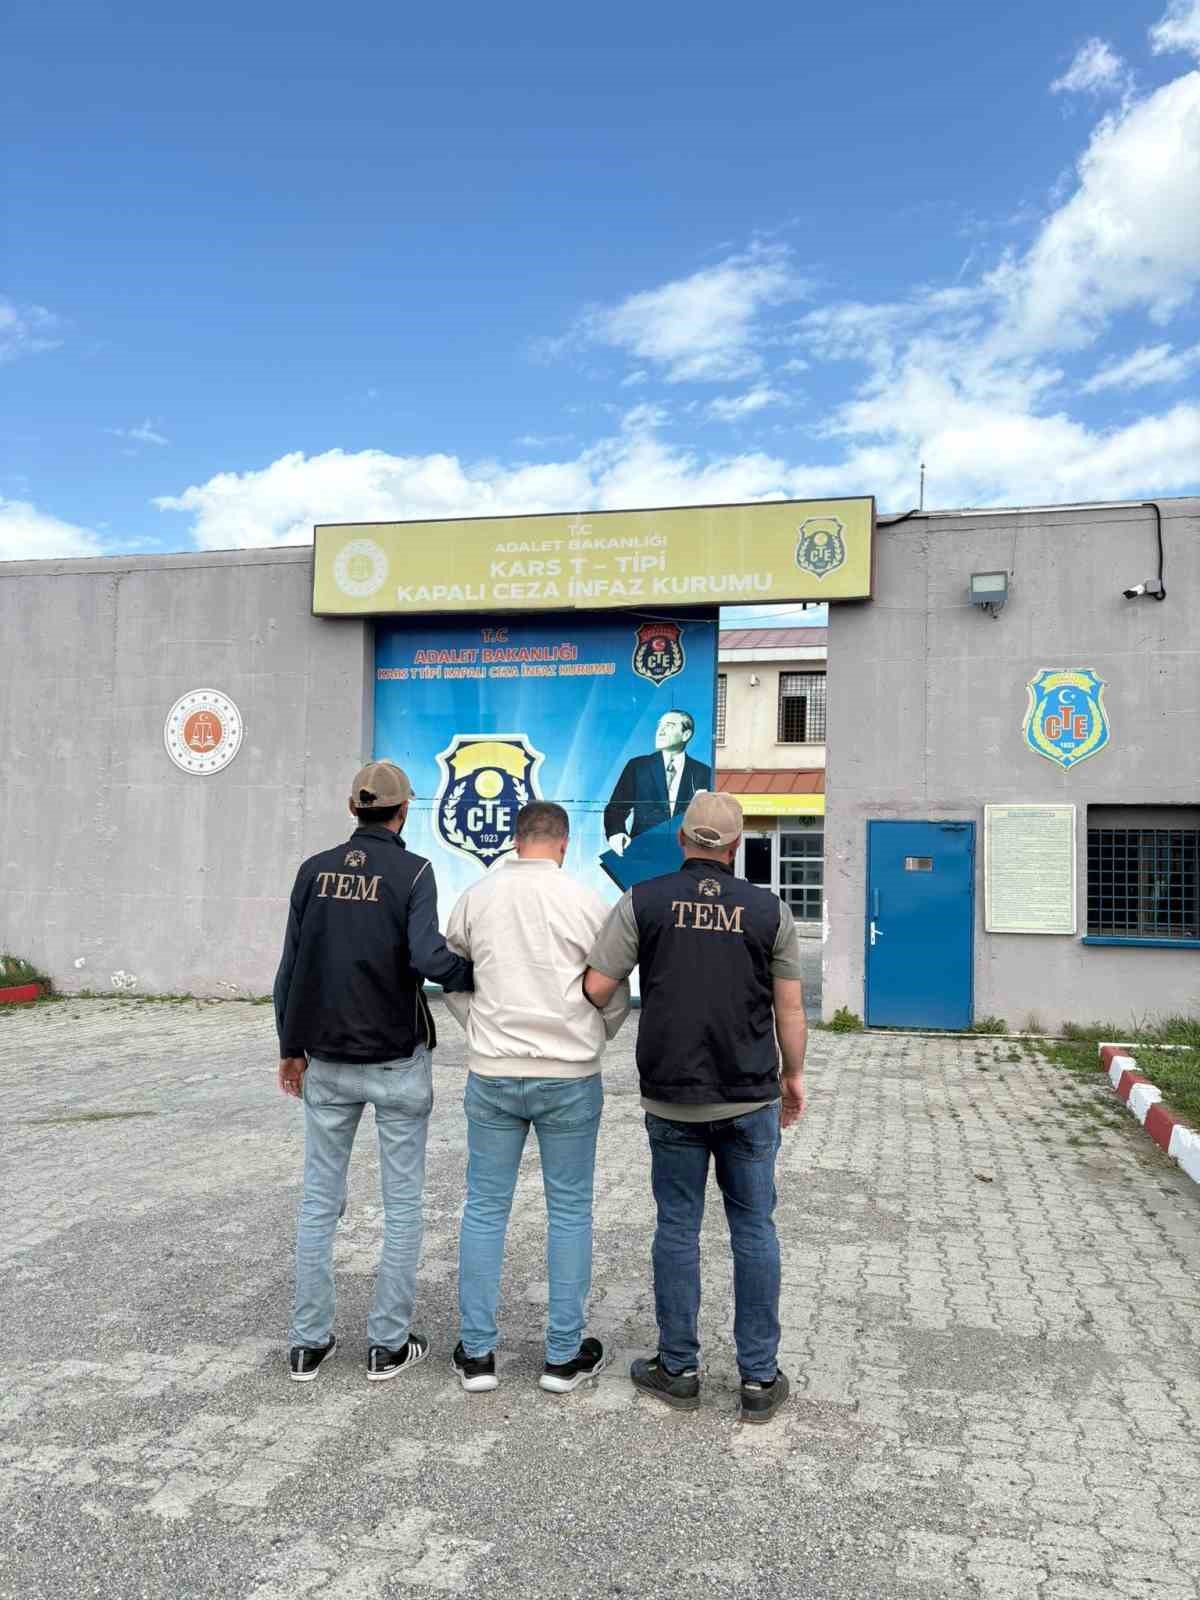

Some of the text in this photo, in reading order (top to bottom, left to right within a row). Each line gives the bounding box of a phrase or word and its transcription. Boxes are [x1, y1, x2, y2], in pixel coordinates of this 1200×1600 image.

[495, 540, 564, 553] ADALET
[810, 546, 832, 562] CTE
[490, 559, 562, 577] KARS
[569, 558, 591, 576] T
[614, 551, 667, 574] TİPİ
[397, 572, 775, 603] KAPALI CEZA İNFAZ KURUMU
[414, 642, 578, 665] ADALET BAKANLIĞI
[647, 651, 670, 668] CTE
[443, 665, 487, 679] KAPALI
[558, 661, 616, 676] KURUMU
[1044, 705, 1089, 740] CTE
[467, 799, 511, 832] CTE
[315, 871, 383, 902] TEM
[671, 900, 745, 934] TEM
